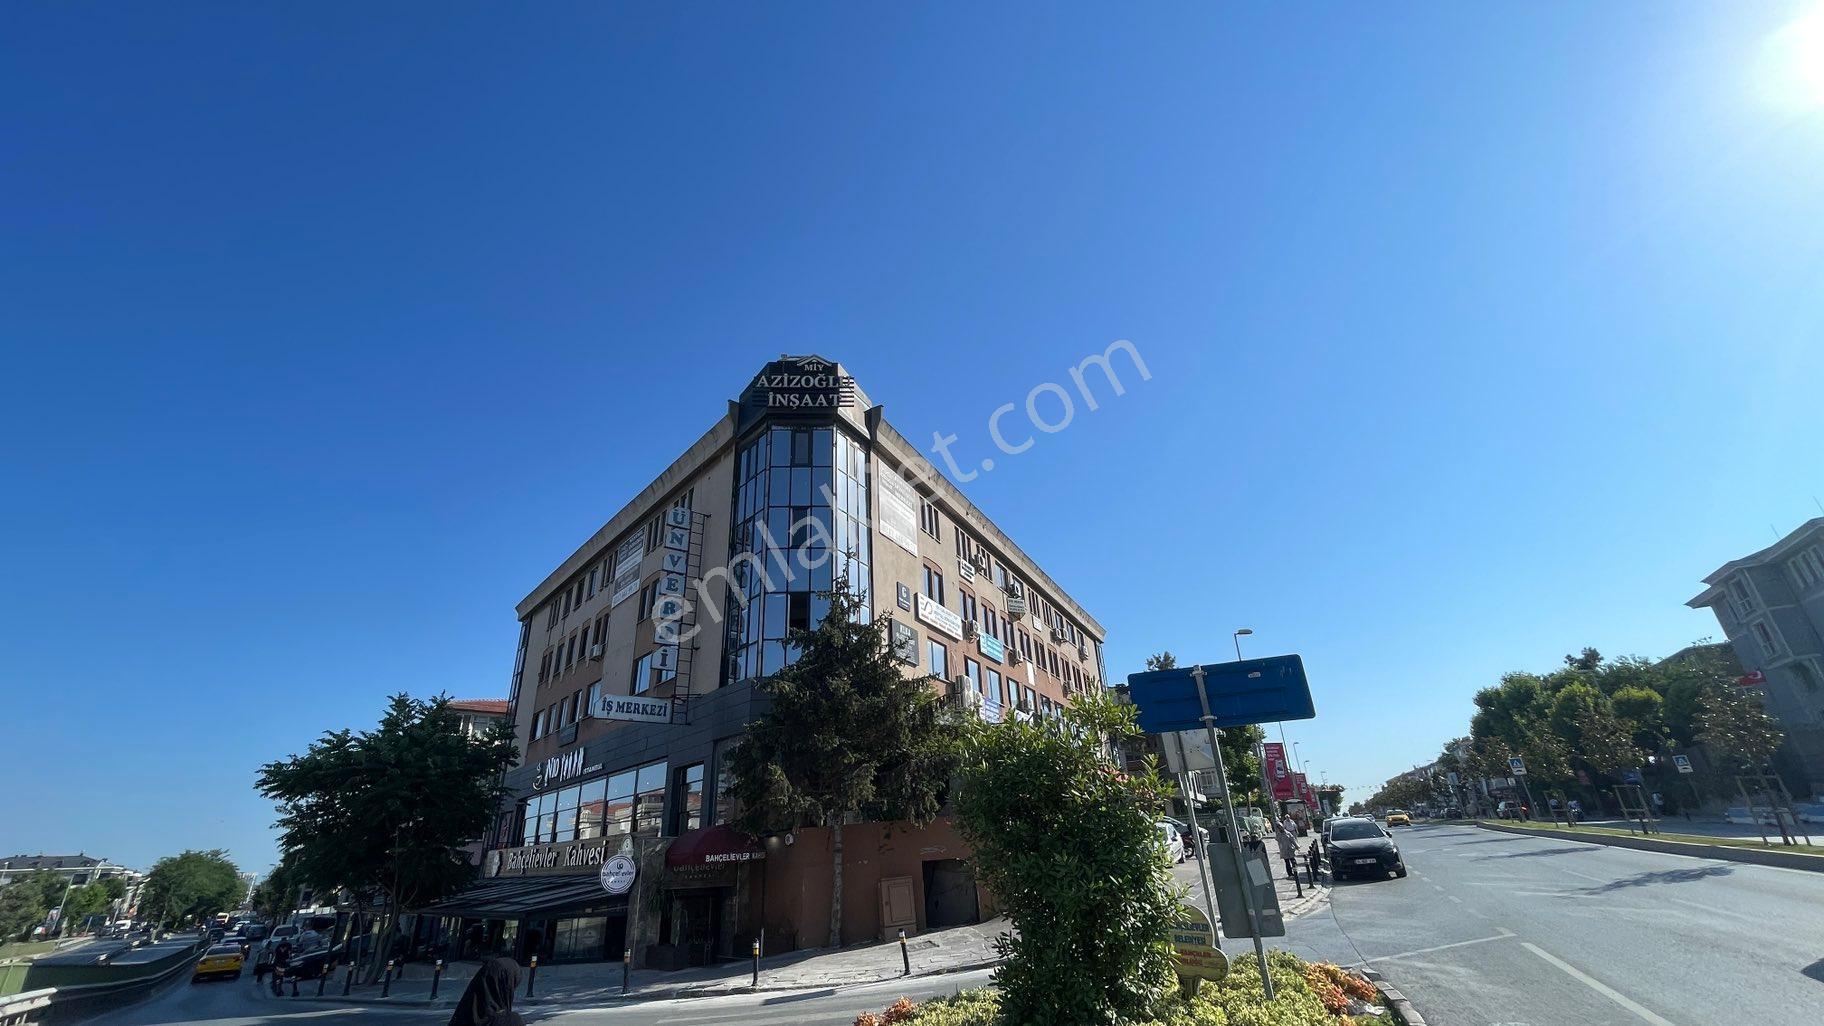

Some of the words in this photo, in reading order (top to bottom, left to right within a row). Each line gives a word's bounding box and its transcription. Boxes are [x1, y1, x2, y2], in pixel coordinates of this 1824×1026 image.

[768, 391, 841, 409] İNŞAAT
[601, 697, 614, 716] İŞ
[615, 702, 669, 717] MERKEZİ
[507, 850, 558, 874] Bahçelievler
[563, 840, 608, 867] Kahvesi
